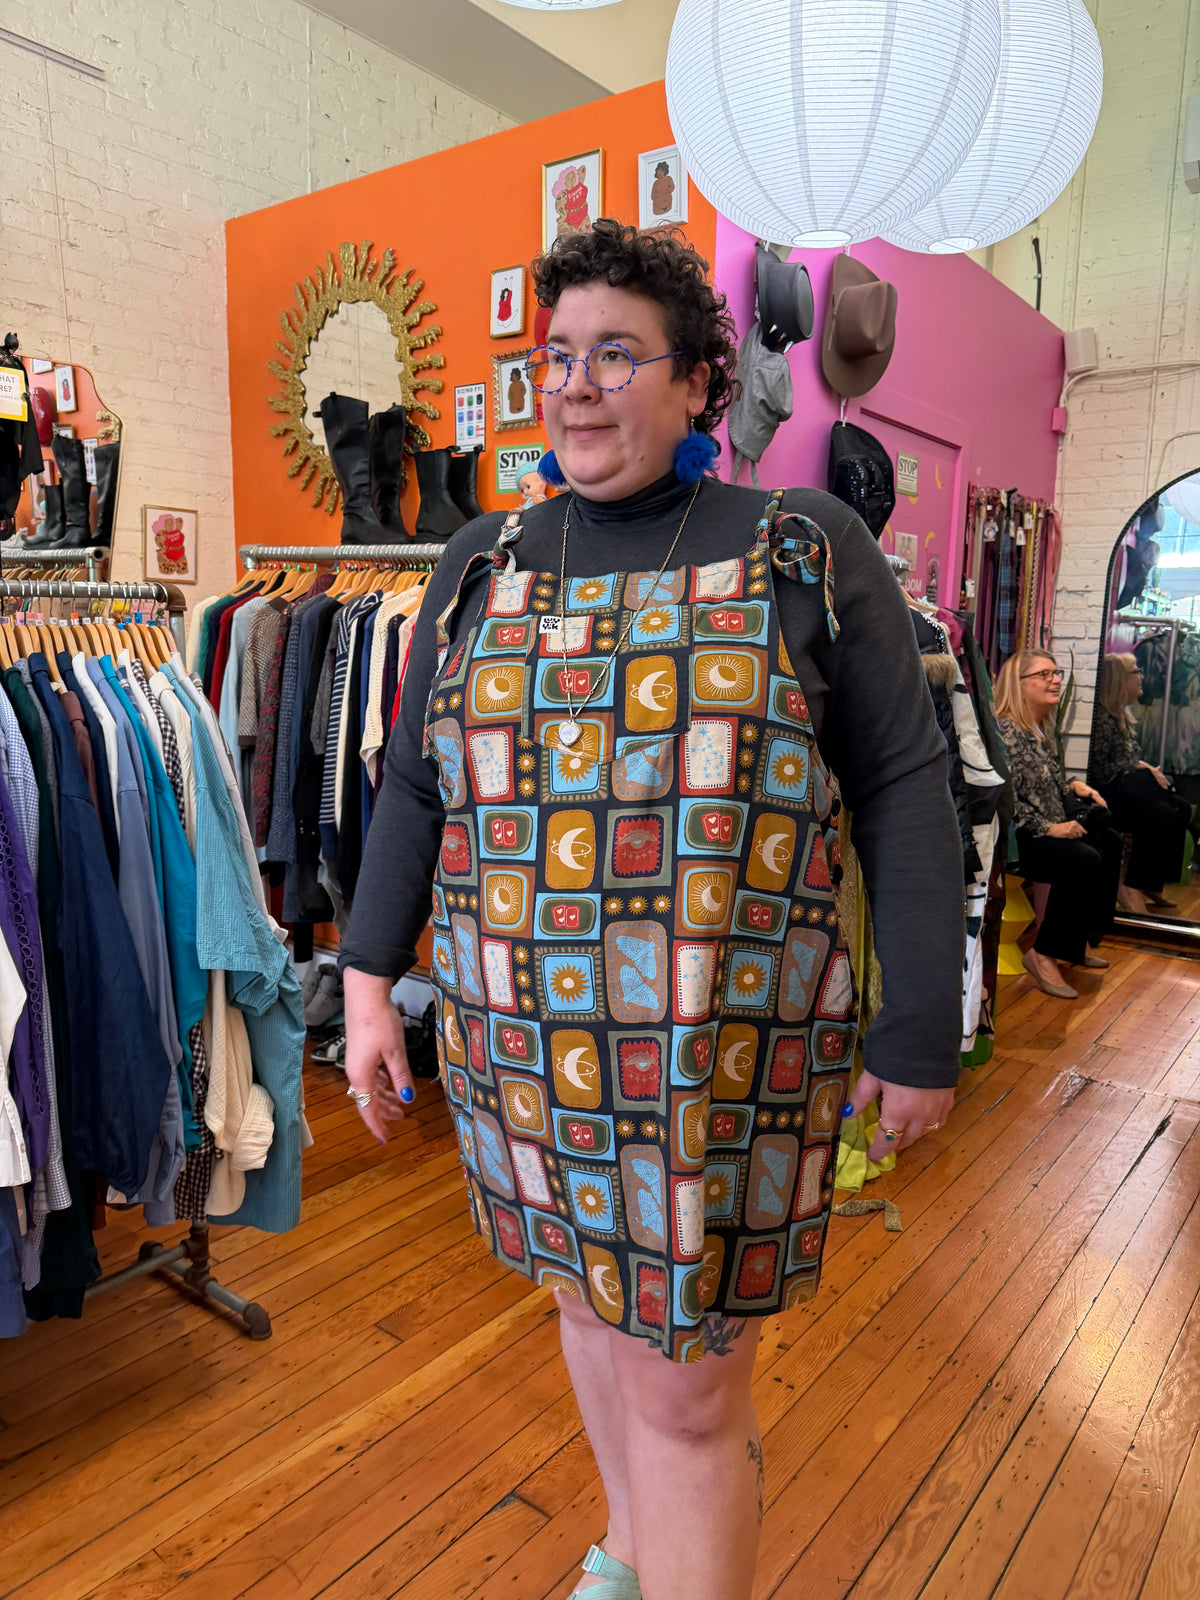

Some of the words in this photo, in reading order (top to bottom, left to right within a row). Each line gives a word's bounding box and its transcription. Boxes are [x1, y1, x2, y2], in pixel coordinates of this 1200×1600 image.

[500, 450, 540, 469] STOP
[899, 457, 918, 474] STOP
[905, 579, 922, 592] OOM
